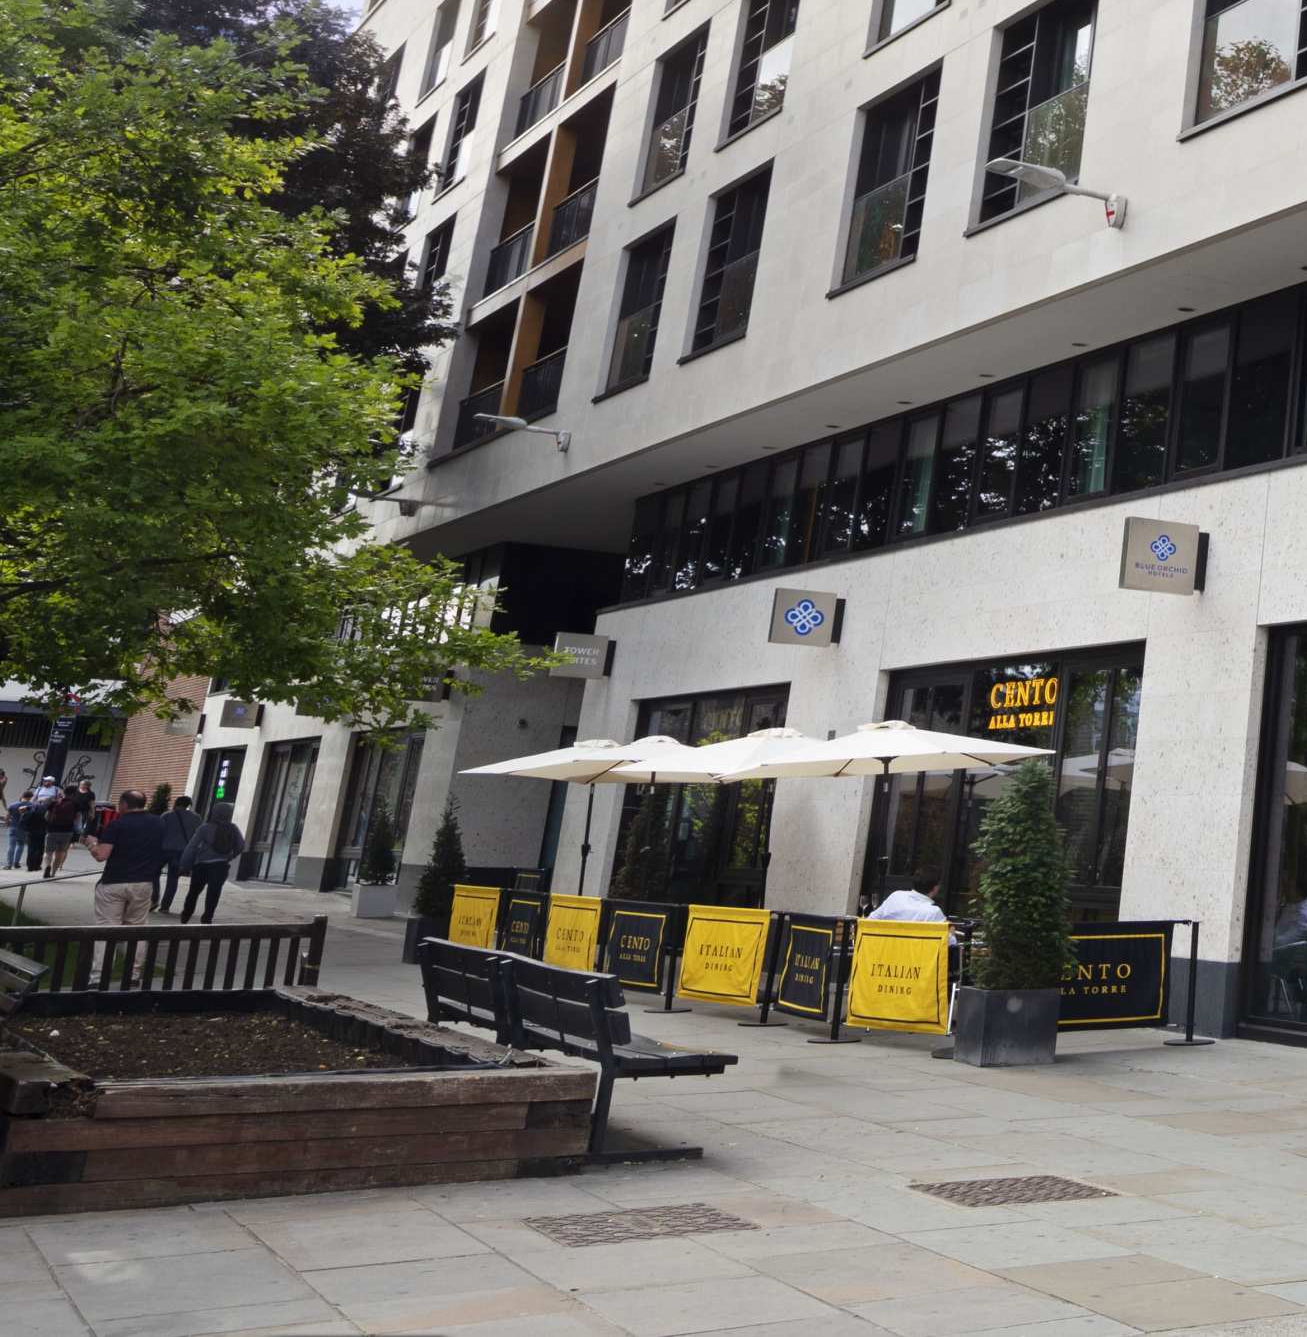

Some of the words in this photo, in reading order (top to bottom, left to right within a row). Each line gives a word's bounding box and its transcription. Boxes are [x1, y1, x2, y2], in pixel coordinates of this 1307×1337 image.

[565, 657, 597, 665] UITES
[990, 677, 1059, 709] CENTO
[988, 714, 1016, 730] ALLA
[620, 934, 651, 951] CENTO
[699, 943, 744, 959] ITALIAN
[704, 962, 734, 972] DINING
[794, 953, 821, 970] ITALIAN
[870, 963, 922, 980] ITALIAN
[1060, 963, 1131, 980] ENTO
[877, 983, 913, 996] DINING
[1083, 984, 1127, 995] TORRE
